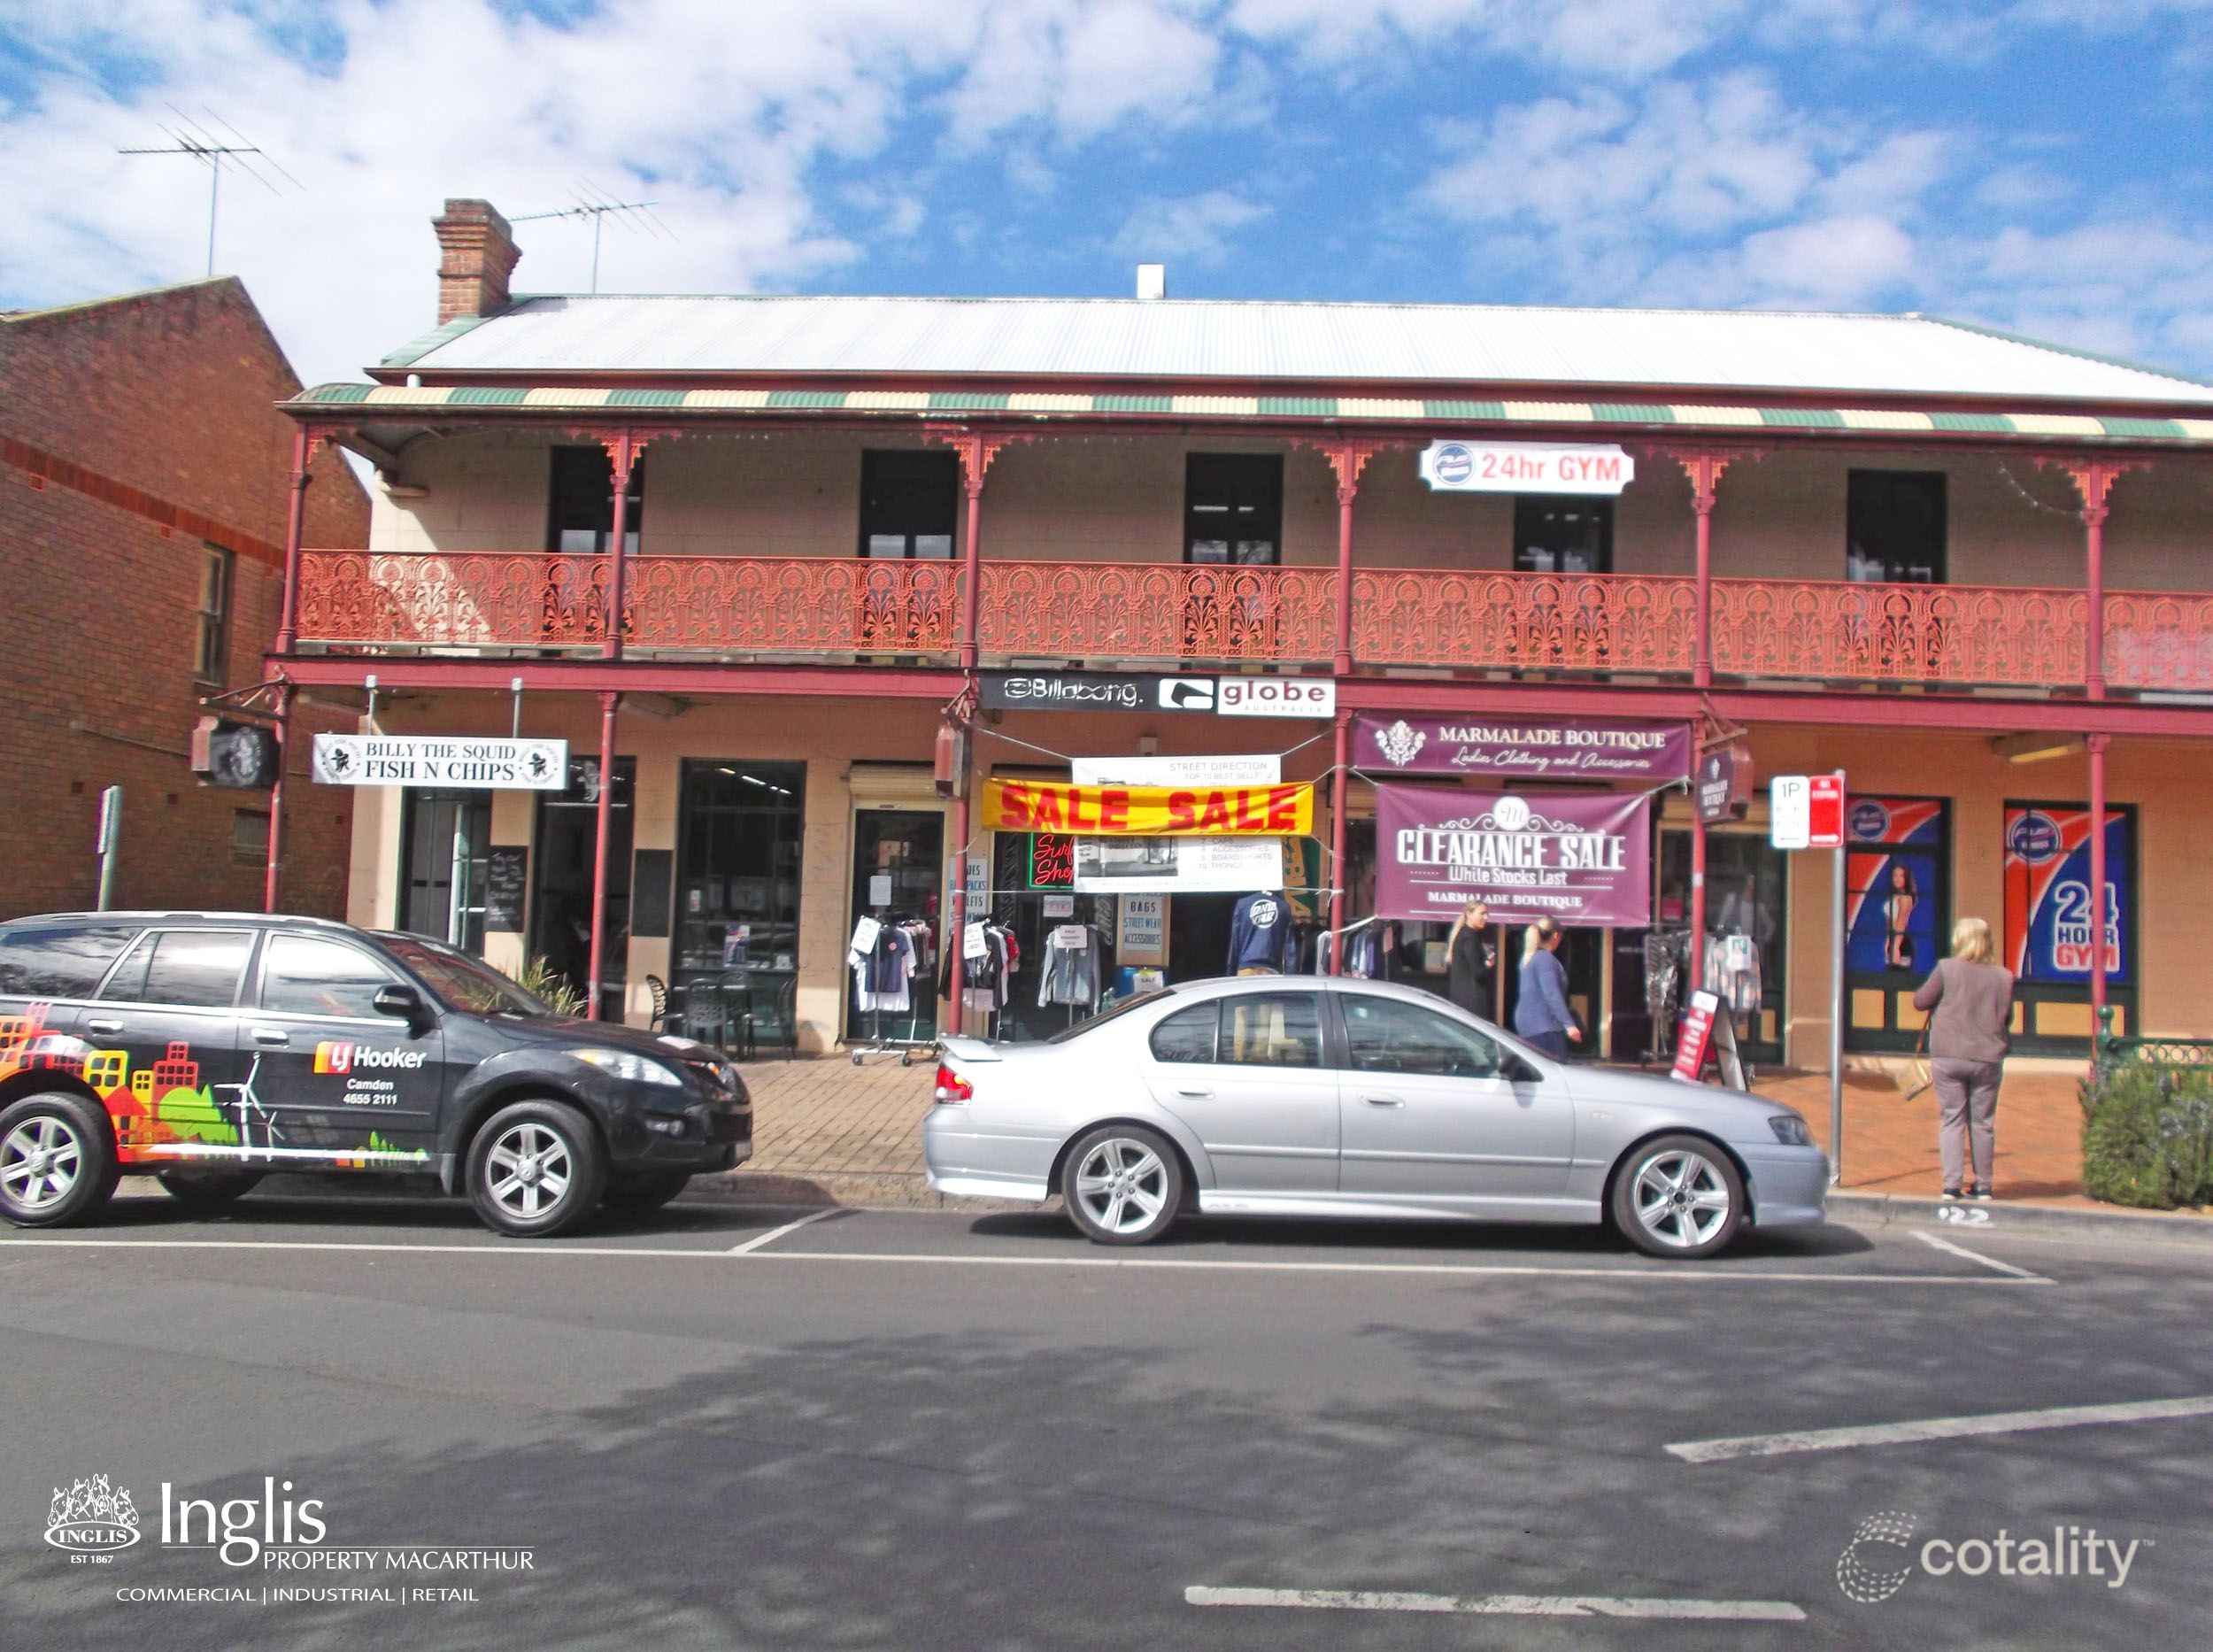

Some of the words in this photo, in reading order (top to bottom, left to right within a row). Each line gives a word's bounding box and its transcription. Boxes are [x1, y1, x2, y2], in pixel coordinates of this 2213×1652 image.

[1481, 452, 1546, 480] 24hr
[1558, 456, 1621, 482] GYM
[1223, 680, 1327, 706] globe
[1438, 726, 1561, 745] MARMALADE
[1565, 730, 1666, 750] BOUTIQUE
[365, 742, 417, 757] BILLY
[421, 744, 457, 758] THE
[461, 745, 516, 760] SQUID
[1450, 745, 1492, 765] Ladies
[1494, 748, 1552, 773] Clothing
[1554, 749, 1579, 767] and
[1579, 751, 1654, 769] Accessories
[364, 760, 415, 779] FISH
[424, 762, 440, 779] N
[447, 762, 516, 782] CHIPS
[1169, 762, 1207, 772] STREET
[1211, 761, 1268, 771] DIRECTION
[1782, 782, 1800, 798] 1P
[1000, 784, 1130, 830] SALE
[1168, 787, 1298, 830] SALE
[1034, 833, 1075, 865] Surf
[1396, 829, 1549, 868] CLEARANCE
[1559, 834, 1626, 870] SALE
[1035, 859, 1075, 885] Shop
[1448, 866, 1491, 884] While
[1493, 868, 1538, 885] Stocks
[1538, 868, 1568, 886] Last
[1130, 901, 1156, 912] BAGS
[1427, 892, 1510, 906] MARMALADE
[1513, 894, 1583, 909] BOUTIQUE
[1124, 916, 1145, 928] STREET
[1124, 933, 1161, 945] ACCESSORIES
[2057, 927, 2117, 944] HOR
[354, 1046, 427, 1069] Hooker
[346, 1078, 394, 1091] Camden
[373, 1094, 397, 1105] 2111
